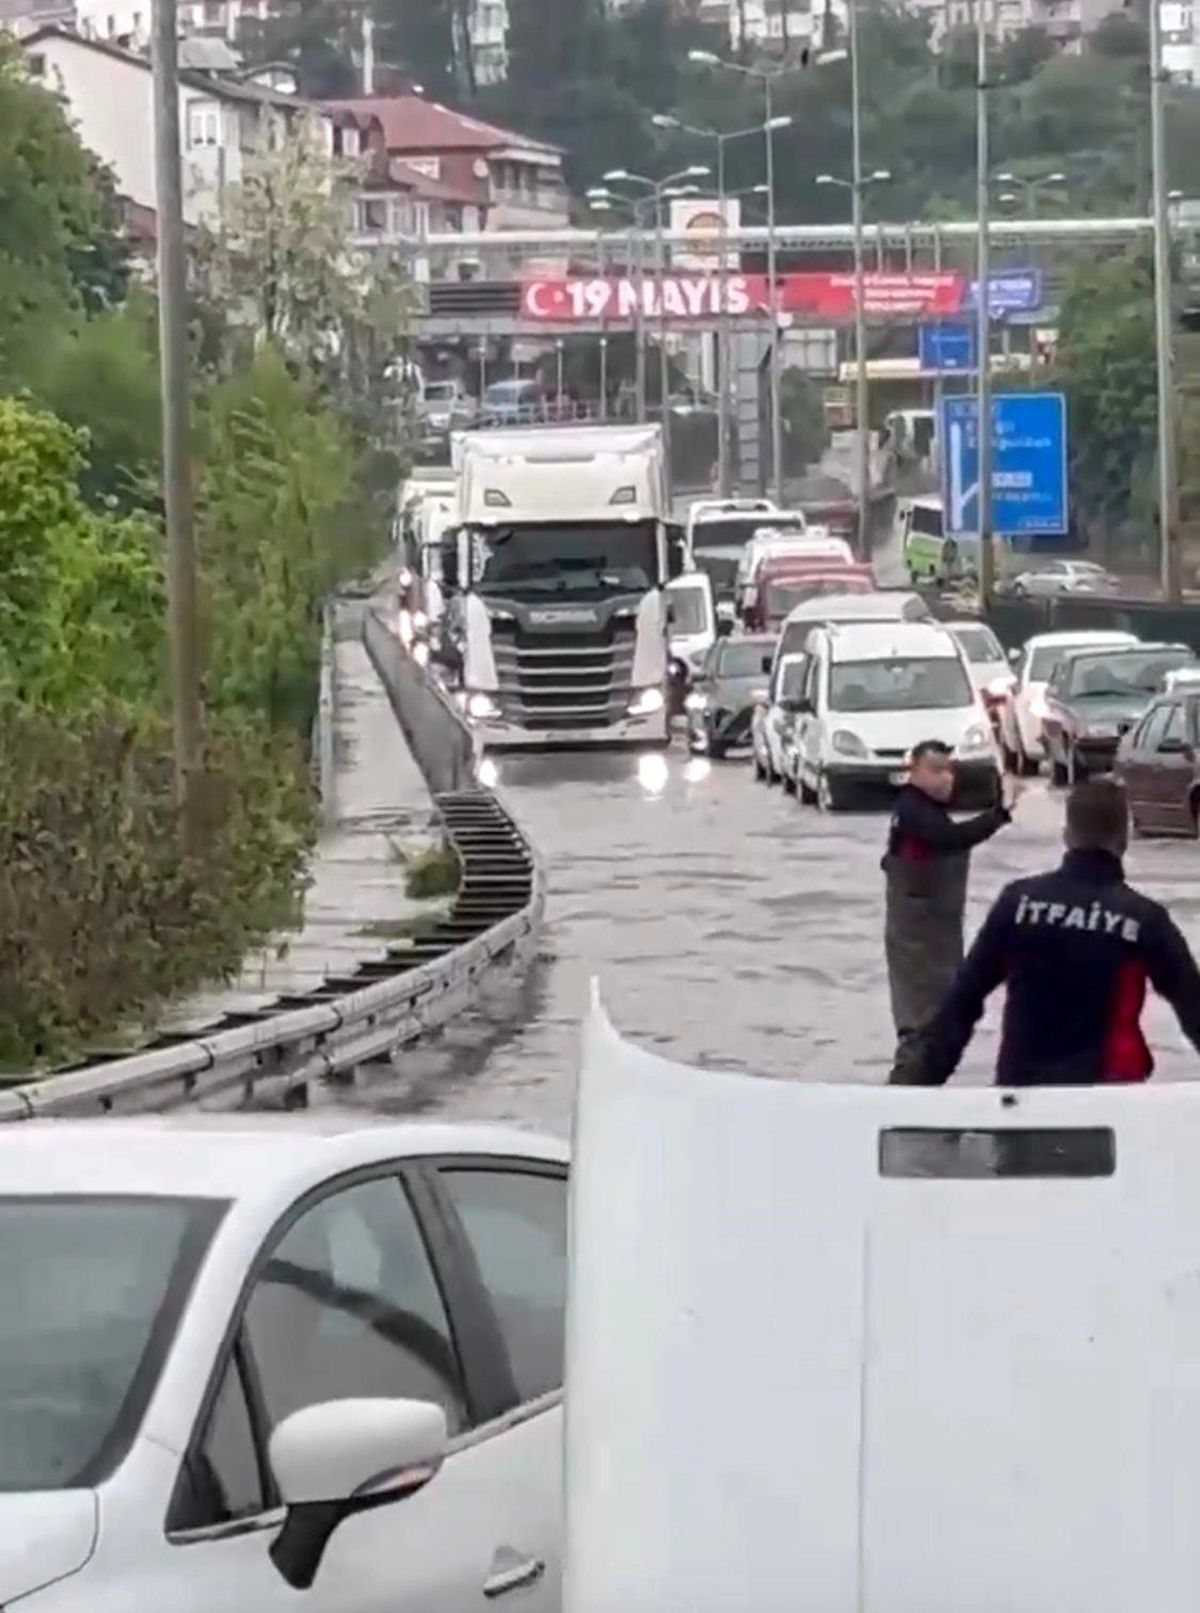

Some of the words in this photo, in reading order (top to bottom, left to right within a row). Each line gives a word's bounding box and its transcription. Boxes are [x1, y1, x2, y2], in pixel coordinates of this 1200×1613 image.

[566, 280, 611, 316] 19
[618, 277, 749, 316] MAYIS
[1015, 894, 1141, 943] İTFAİYE
